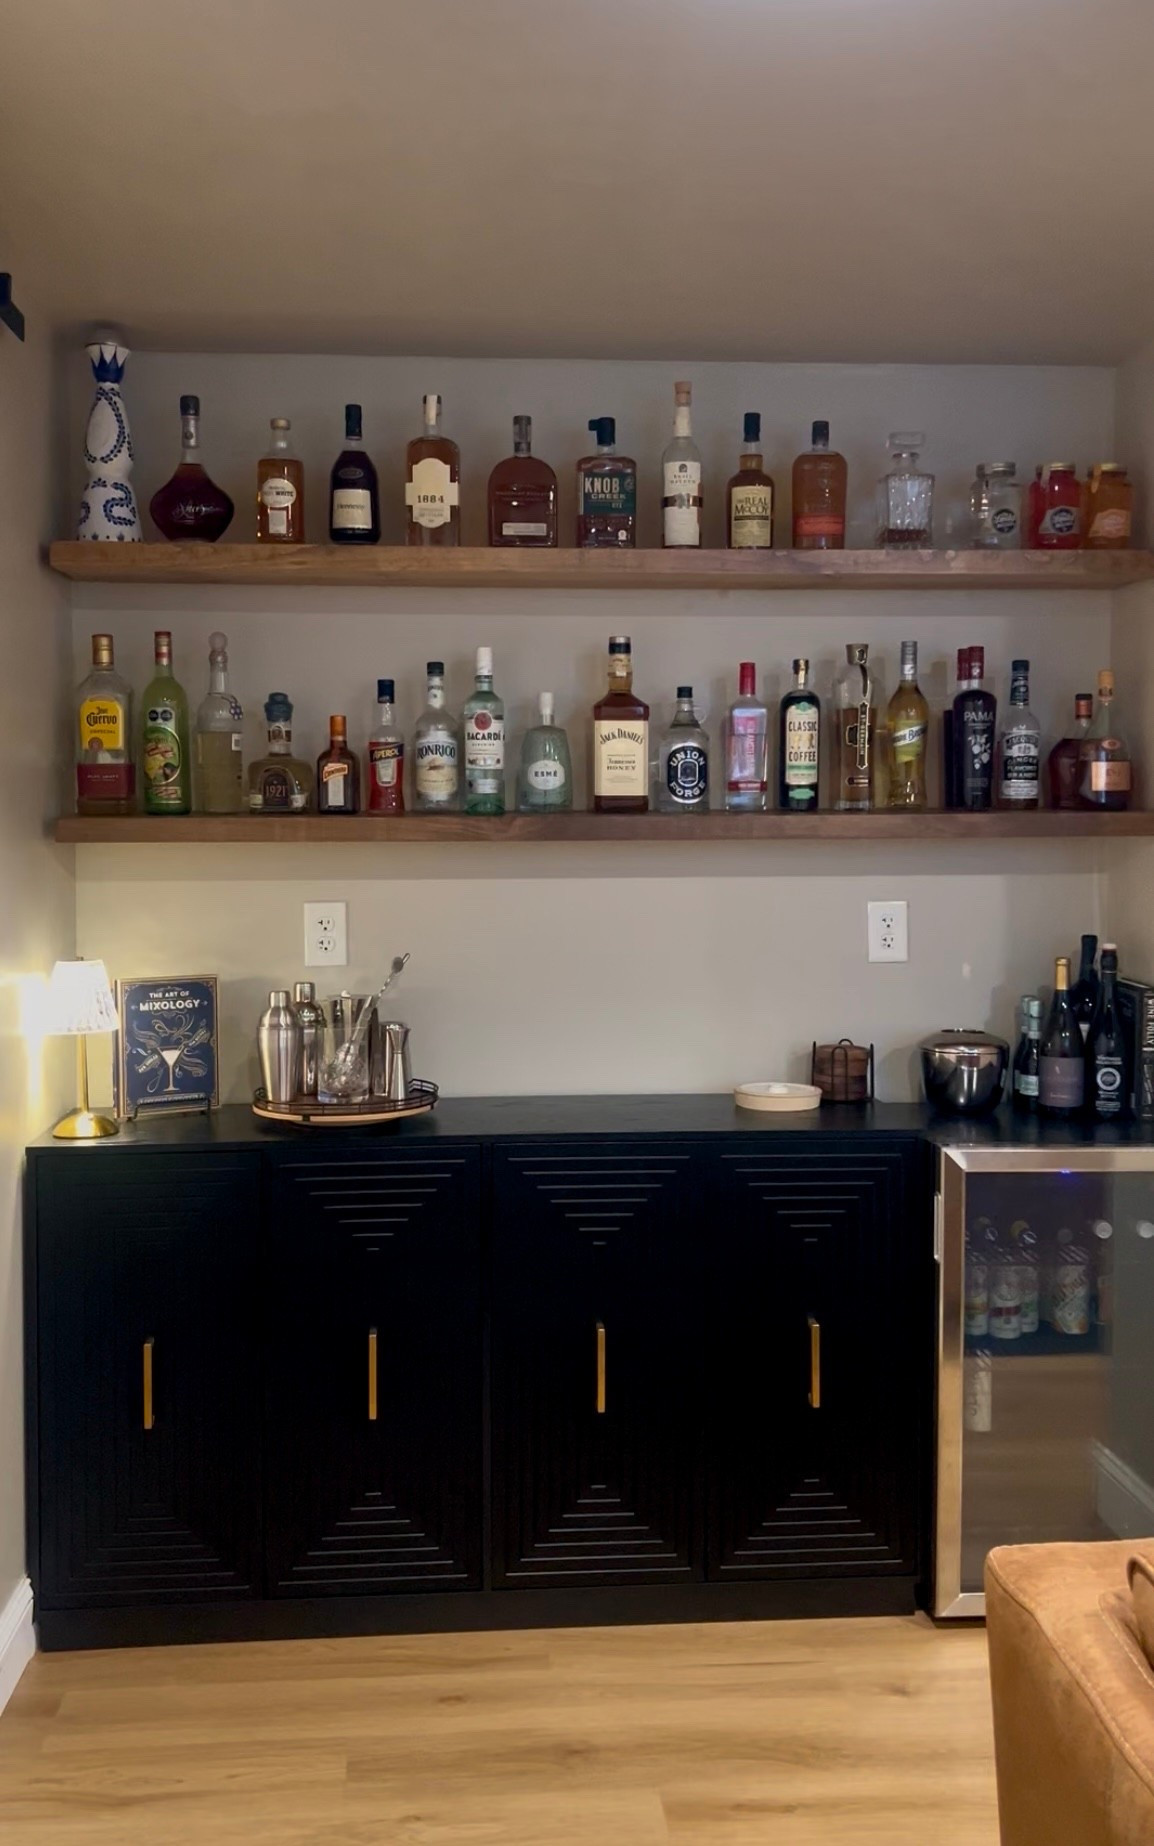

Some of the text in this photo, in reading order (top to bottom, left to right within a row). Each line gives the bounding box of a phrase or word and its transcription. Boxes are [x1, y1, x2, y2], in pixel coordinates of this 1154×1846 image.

[585, 476, 620, 494] KNOB
[417, 495, 444, 504] 1884
[745, 496, 768, 505] REAL
[86, 711, 117, 727] Cuervo
[963, 711, 994, 721] PAMA
[788, 721, 817, 732] CLASSIC
[466, 730, 502, 741] BACARDÍ
[599, 731, 617, 745] JACK
[373, 750, 399, 760] APEROL
[416, 744, 456, 759] RONRICO
[788, 752, 817, 762] COFFEE
[669, 750, 705, 767] UNION
[534, 769, 558, 778] ESMÉ
[266, 785, 285, 797] 1921
[669, 781, 705, 798] FORGE
[139, 999, 200, 1012] MIXOLOGY
